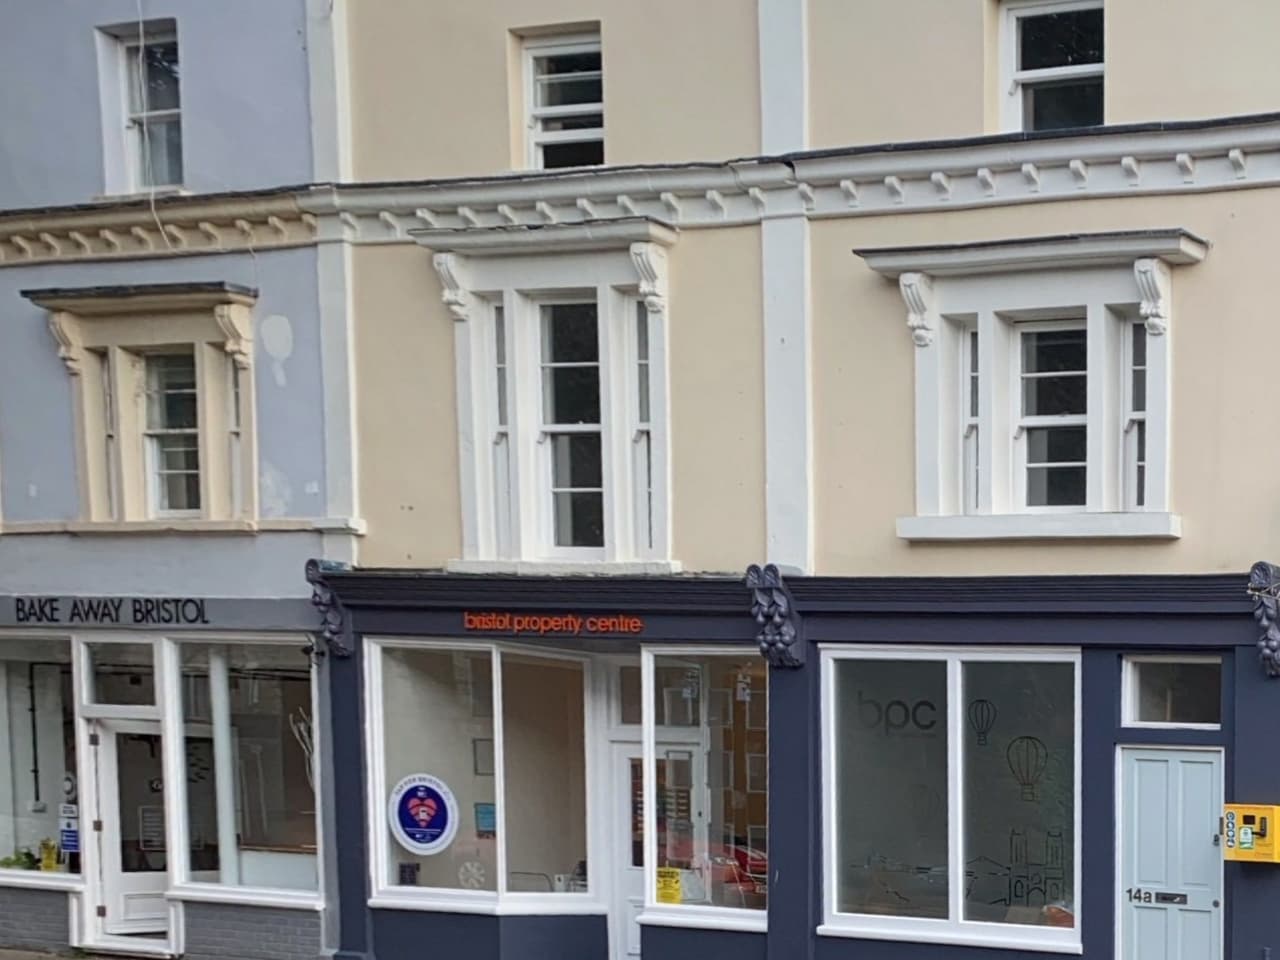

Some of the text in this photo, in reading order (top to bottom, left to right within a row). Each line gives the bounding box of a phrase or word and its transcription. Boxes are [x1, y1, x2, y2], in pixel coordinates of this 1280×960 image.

[16, 598, 210, 624] BAKE AWAY BRISTOL
[464, 611, 642, 635] bristol property centre
[858, 690, 937, 737] bpc
[1125, 888, 1153, 904] 14a
